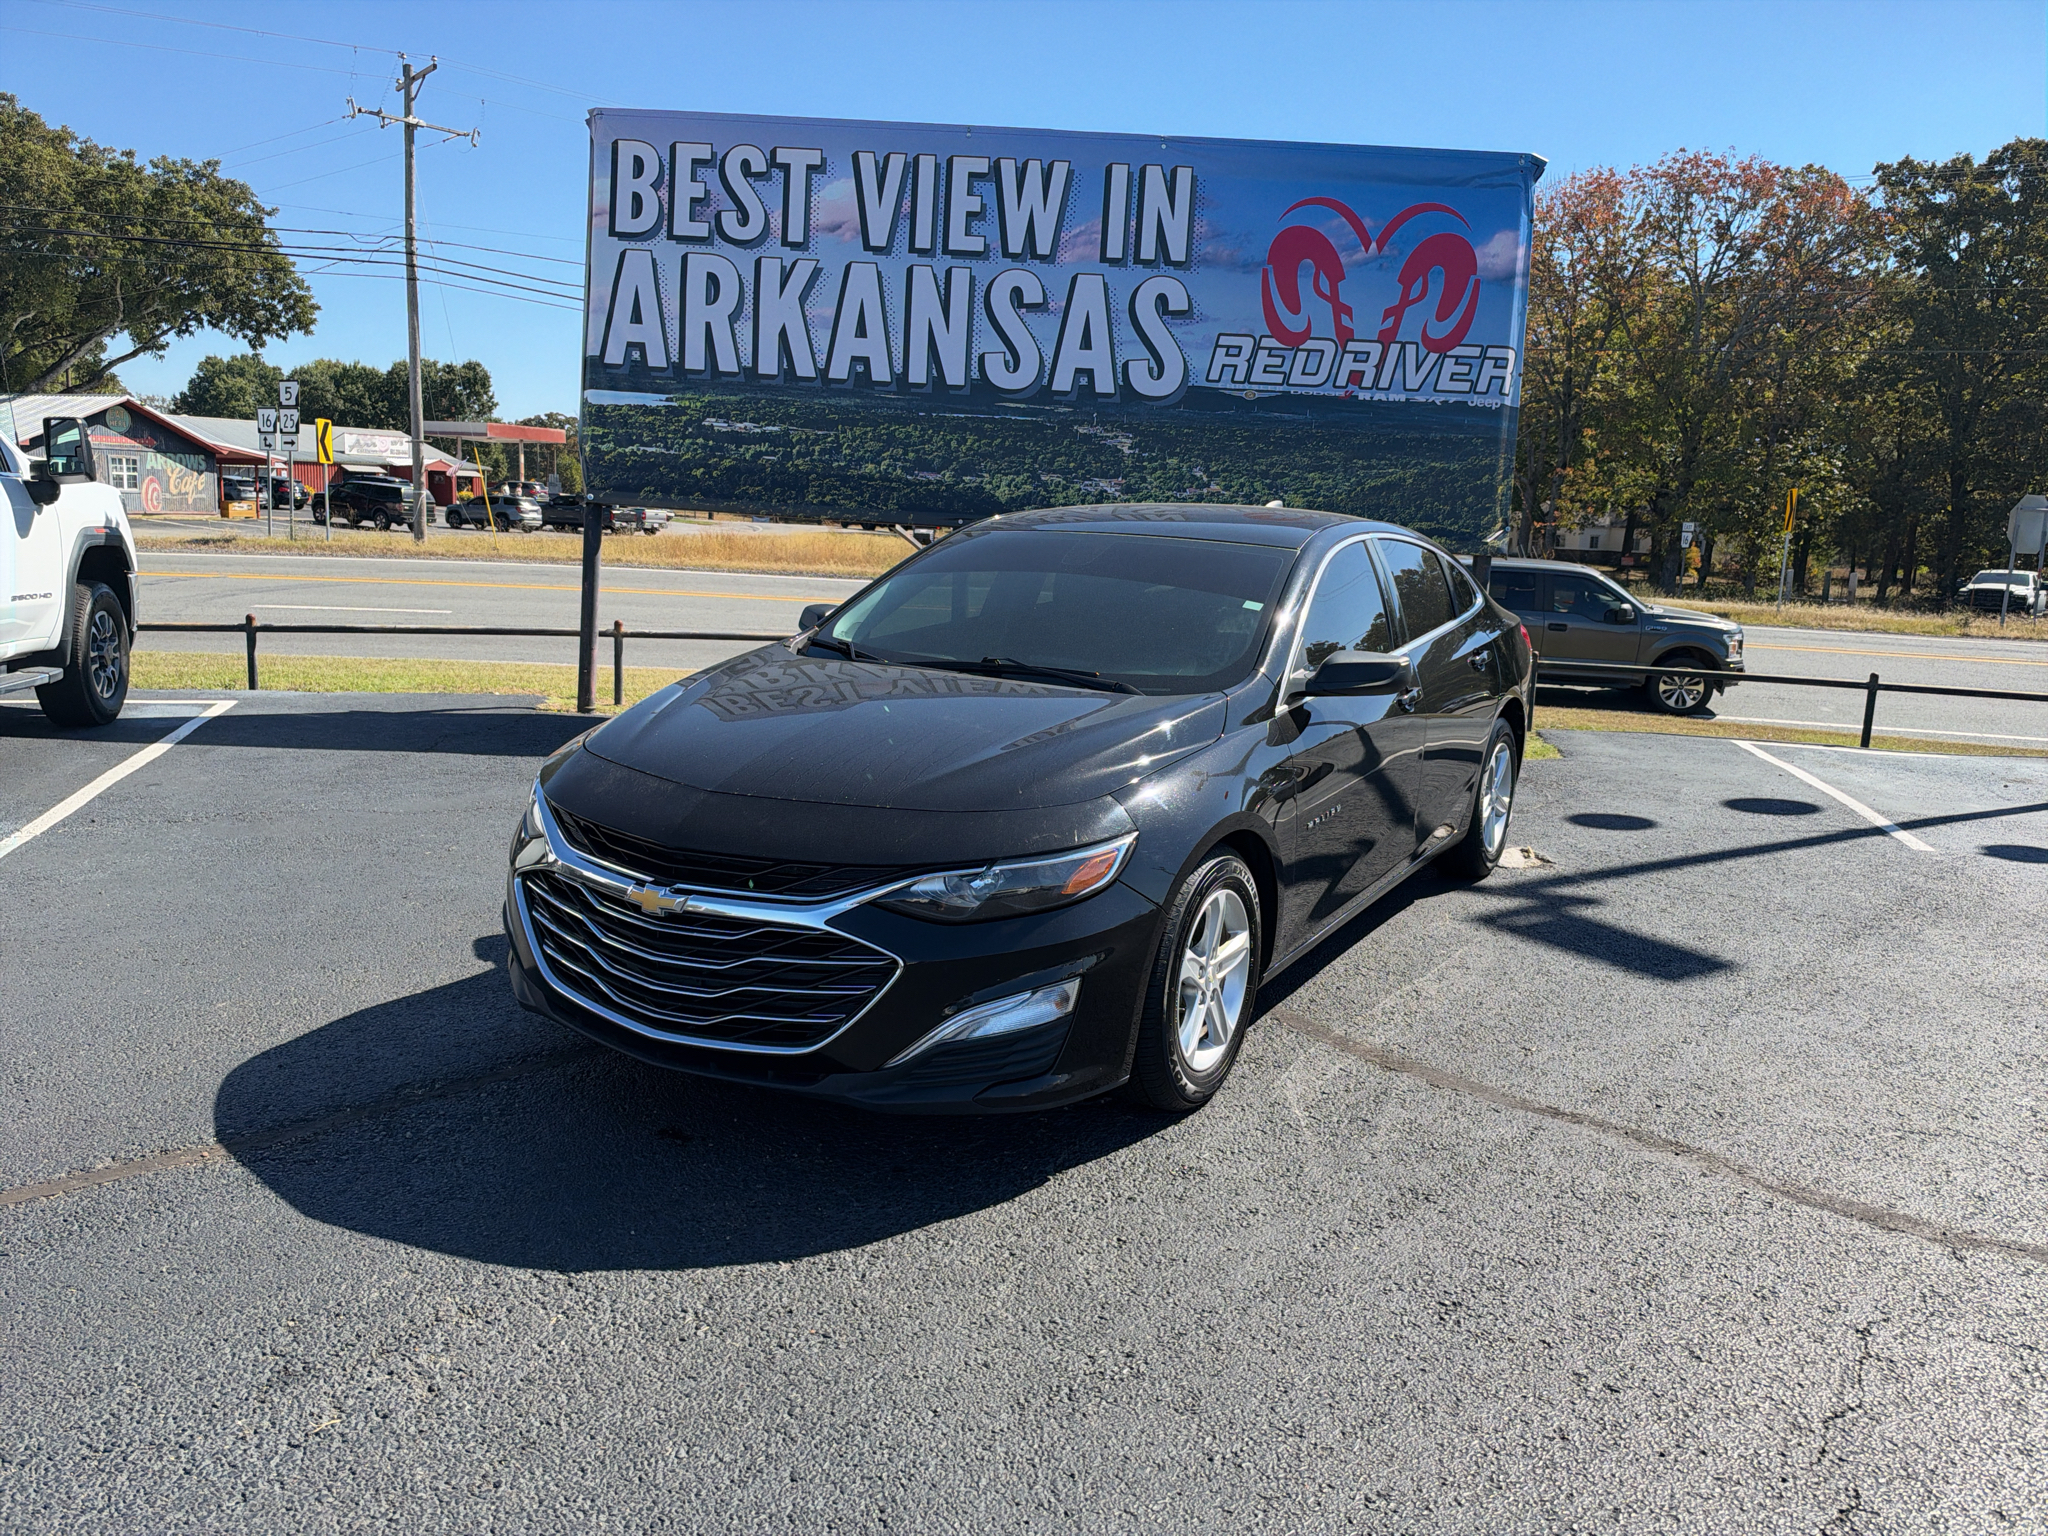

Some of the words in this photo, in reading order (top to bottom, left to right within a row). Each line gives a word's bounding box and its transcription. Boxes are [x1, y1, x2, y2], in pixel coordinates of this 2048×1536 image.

[609, 138, 826, 247] BEST
[852, 150, 1073, 261] VIEW
[1100, 162, 1196, 266] IN
[601, 247, 1194, 400] ARKANSAS
[1205, 332, 1518, 397] REDRIVER
[284, 386, 293, 402] 5
[1358, 392, 1406, 402] RAM
[1468, 394, 1501, 410] Jeep
[108, 408, 125, 419] EAT
[261, 413, 273, 429] 16
[283, 413, 296, 429] 25
[146, 451, 207, 472] ARROWS
